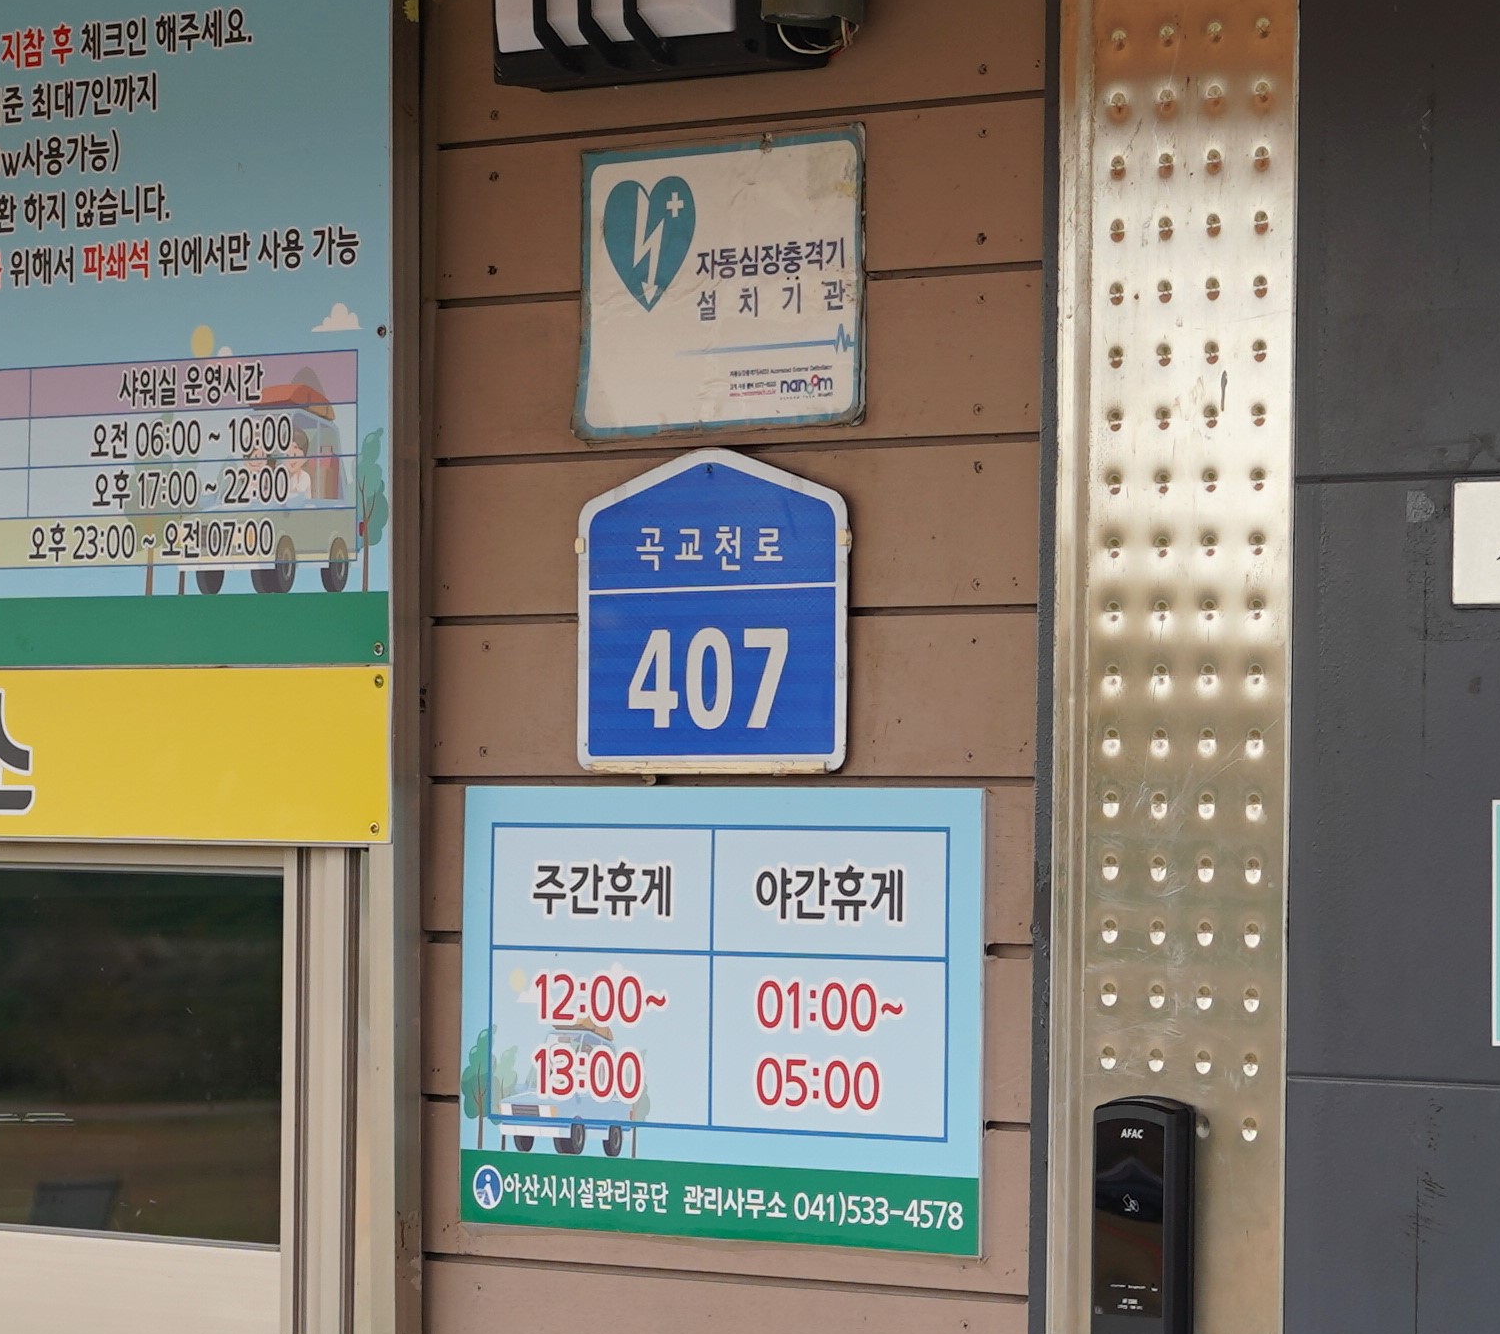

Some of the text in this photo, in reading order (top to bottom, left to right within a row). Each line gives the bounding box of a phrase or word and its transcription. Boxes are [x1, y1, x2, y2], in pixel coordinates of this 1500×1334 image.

[1, 28, 44, 70] 지참
[51, 23, 73, 64] 후
[81, 16, 147, 59] 체크인
[156, 8, 252, 52] 해주세요.
[32, 72, 158, 120] 최대7인까지
[25, 193, 67, 231] 하지
[75, 184, 170, 227] 않습니다.
[11, 247, 74, 287] 위해서
[83, 241, 150, 281] 파쇄석
[159, 232, 250, 275] 위에서만
[258, 228, 303, 270] 사용
[312, 226, 359, 265] 가능
[696, 237, 845, 279] 자동심장충격기
[119, 362, 263, 407] 샤워실 운영시간
[91, 416, 291, 458] 오전 06:00 10:00
[93, 467, 288, 508] 오후 17:00 22:00
[29, 520, 273, 562] 오후 23:00 오전 07:00
[636, 526, 783, 570] 곡교천로
[628, 627, 788, 730] 407
[533, 862, 903, 921] 주간휴게 야간휴게
[534, 974, 667, 1022] 12:00~
[757, 981, 903, 1031] 01:00~
[534, 1049, 642, 1099] 13:00
[756, 1057, 879, 1110] 05:00
[1121, 1128, 1143, 1140] AFAC
[504, 1173, 963, 1228] 아산시시설관리공단 관리사무소 041)533-4578
